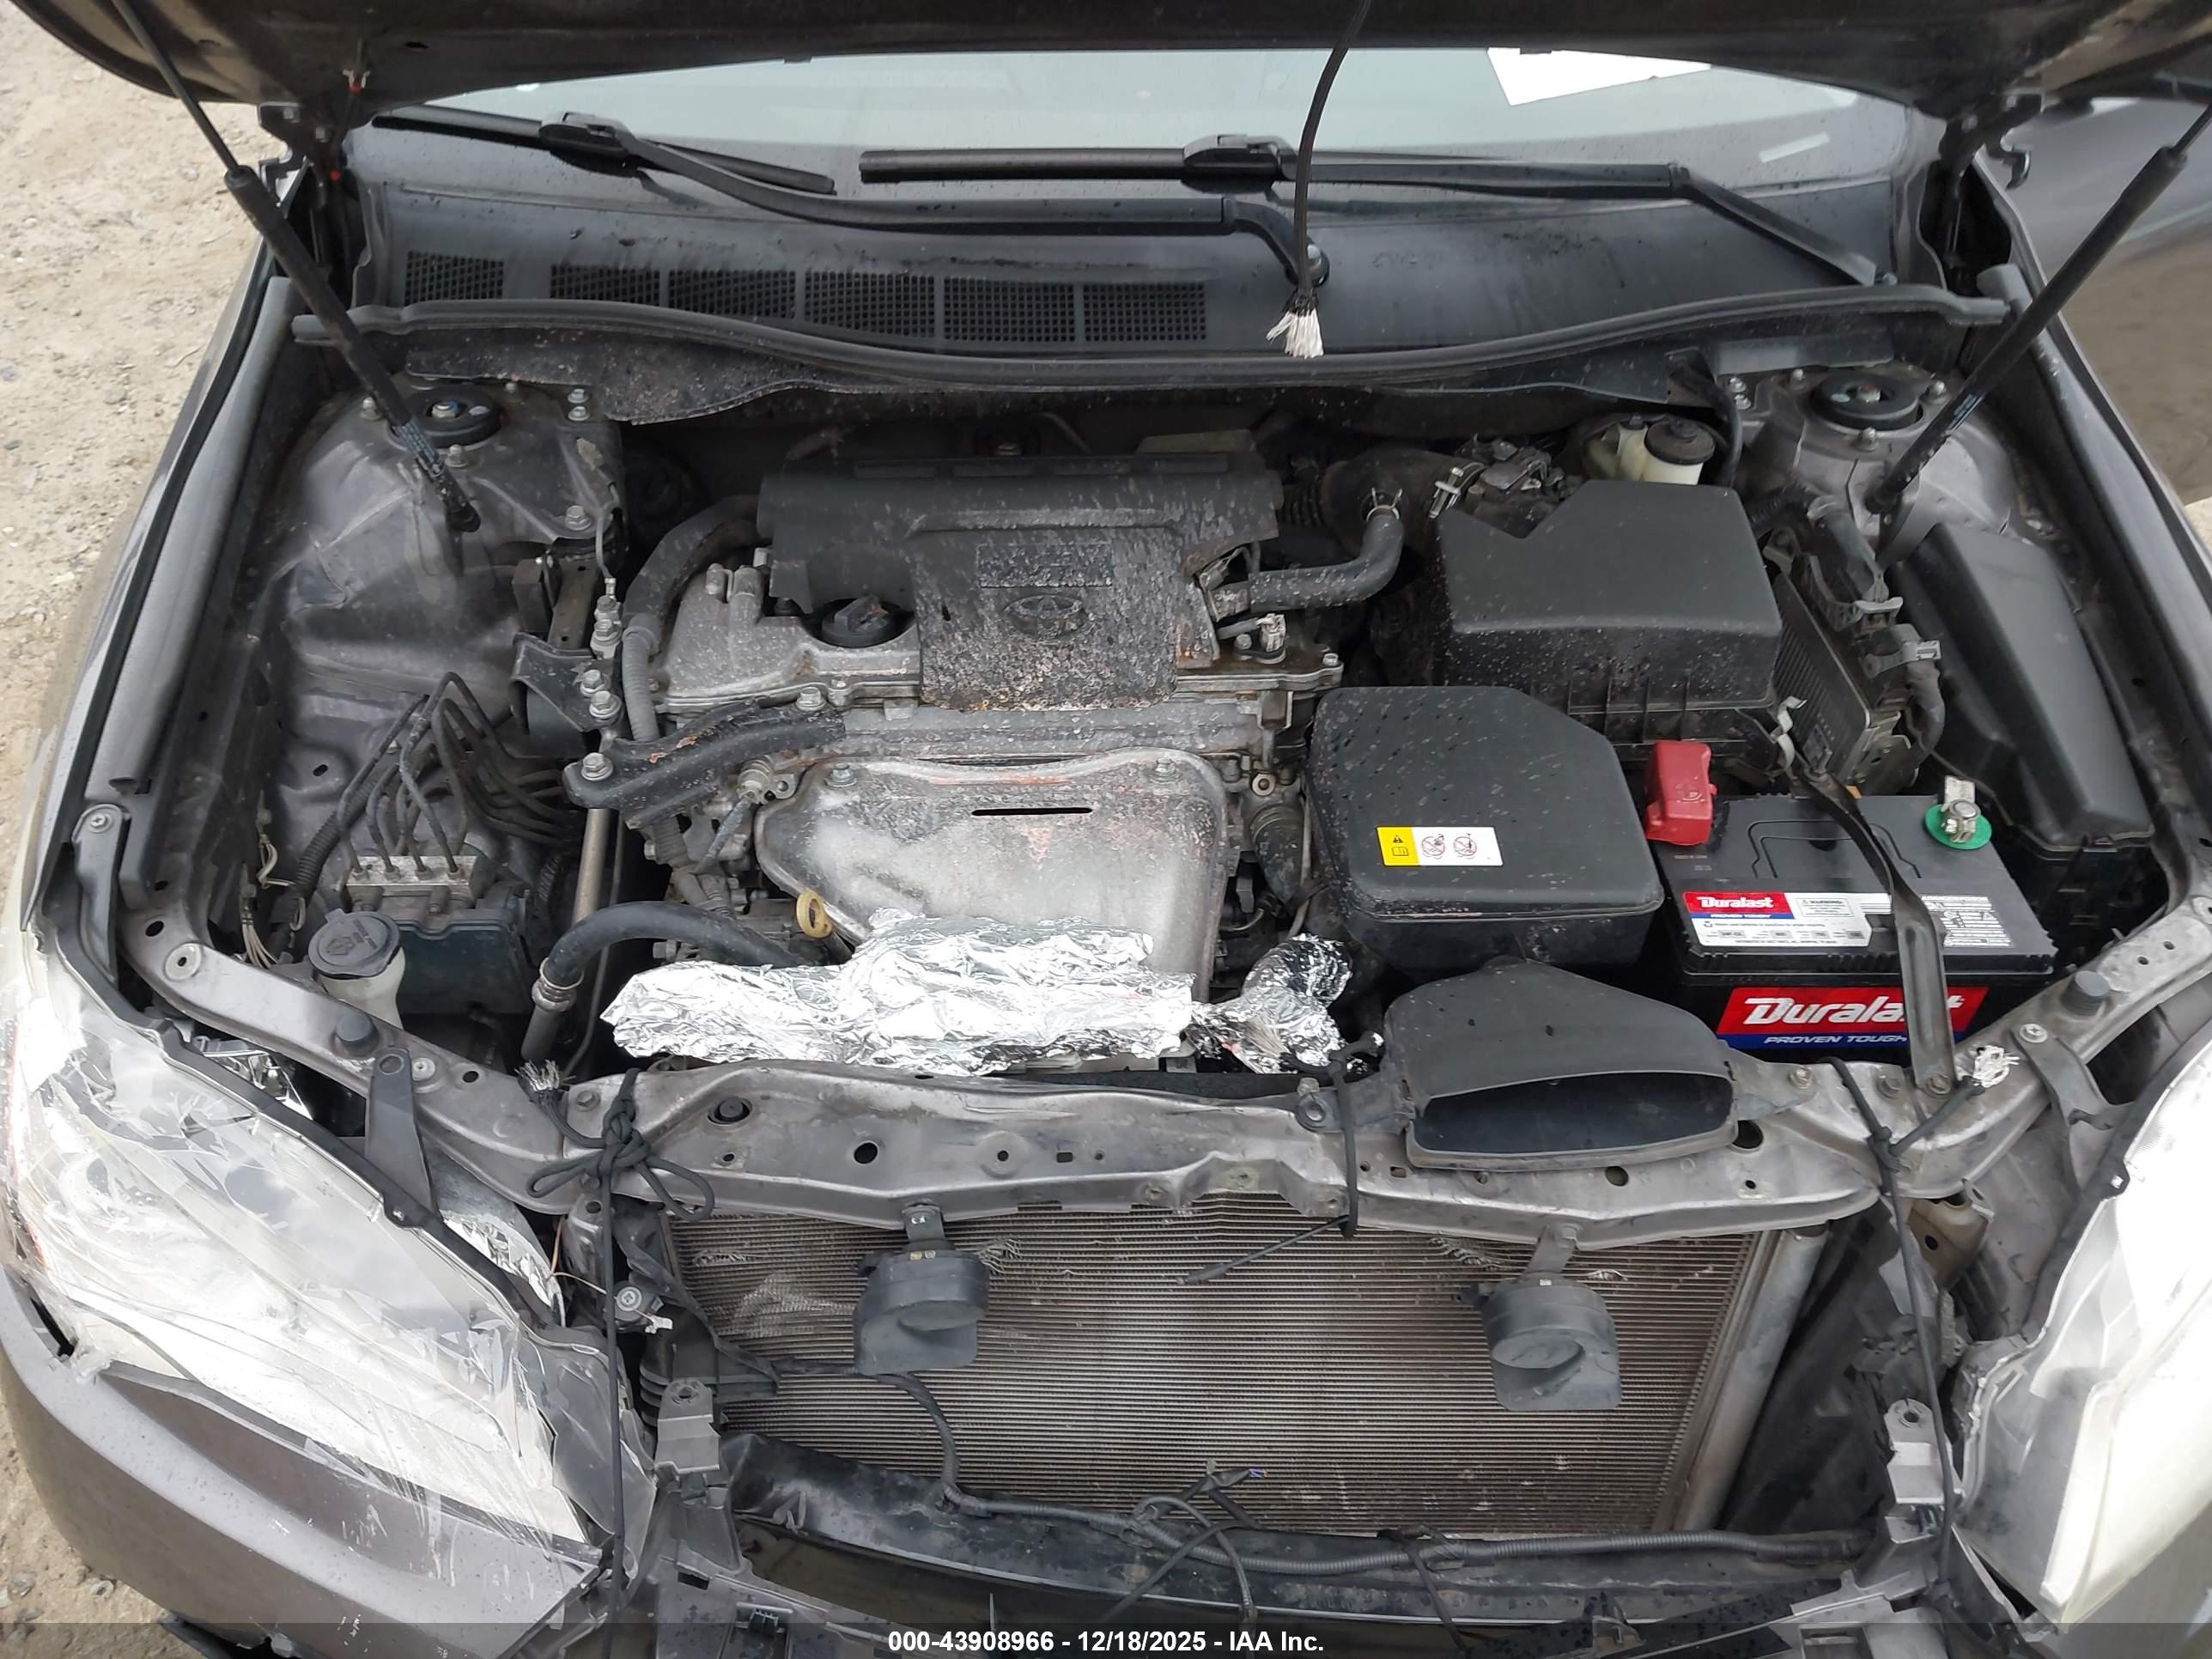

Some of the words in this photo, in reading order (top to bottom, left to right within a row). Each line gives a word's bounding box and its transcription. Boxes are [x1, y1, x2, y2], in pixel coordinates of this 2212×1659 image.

[1696, 896, 1774, 908] Duralast
[1742, 994, 1966, 1025] Duralat
[1763, 1036, 1843, 1044] PROVEN
